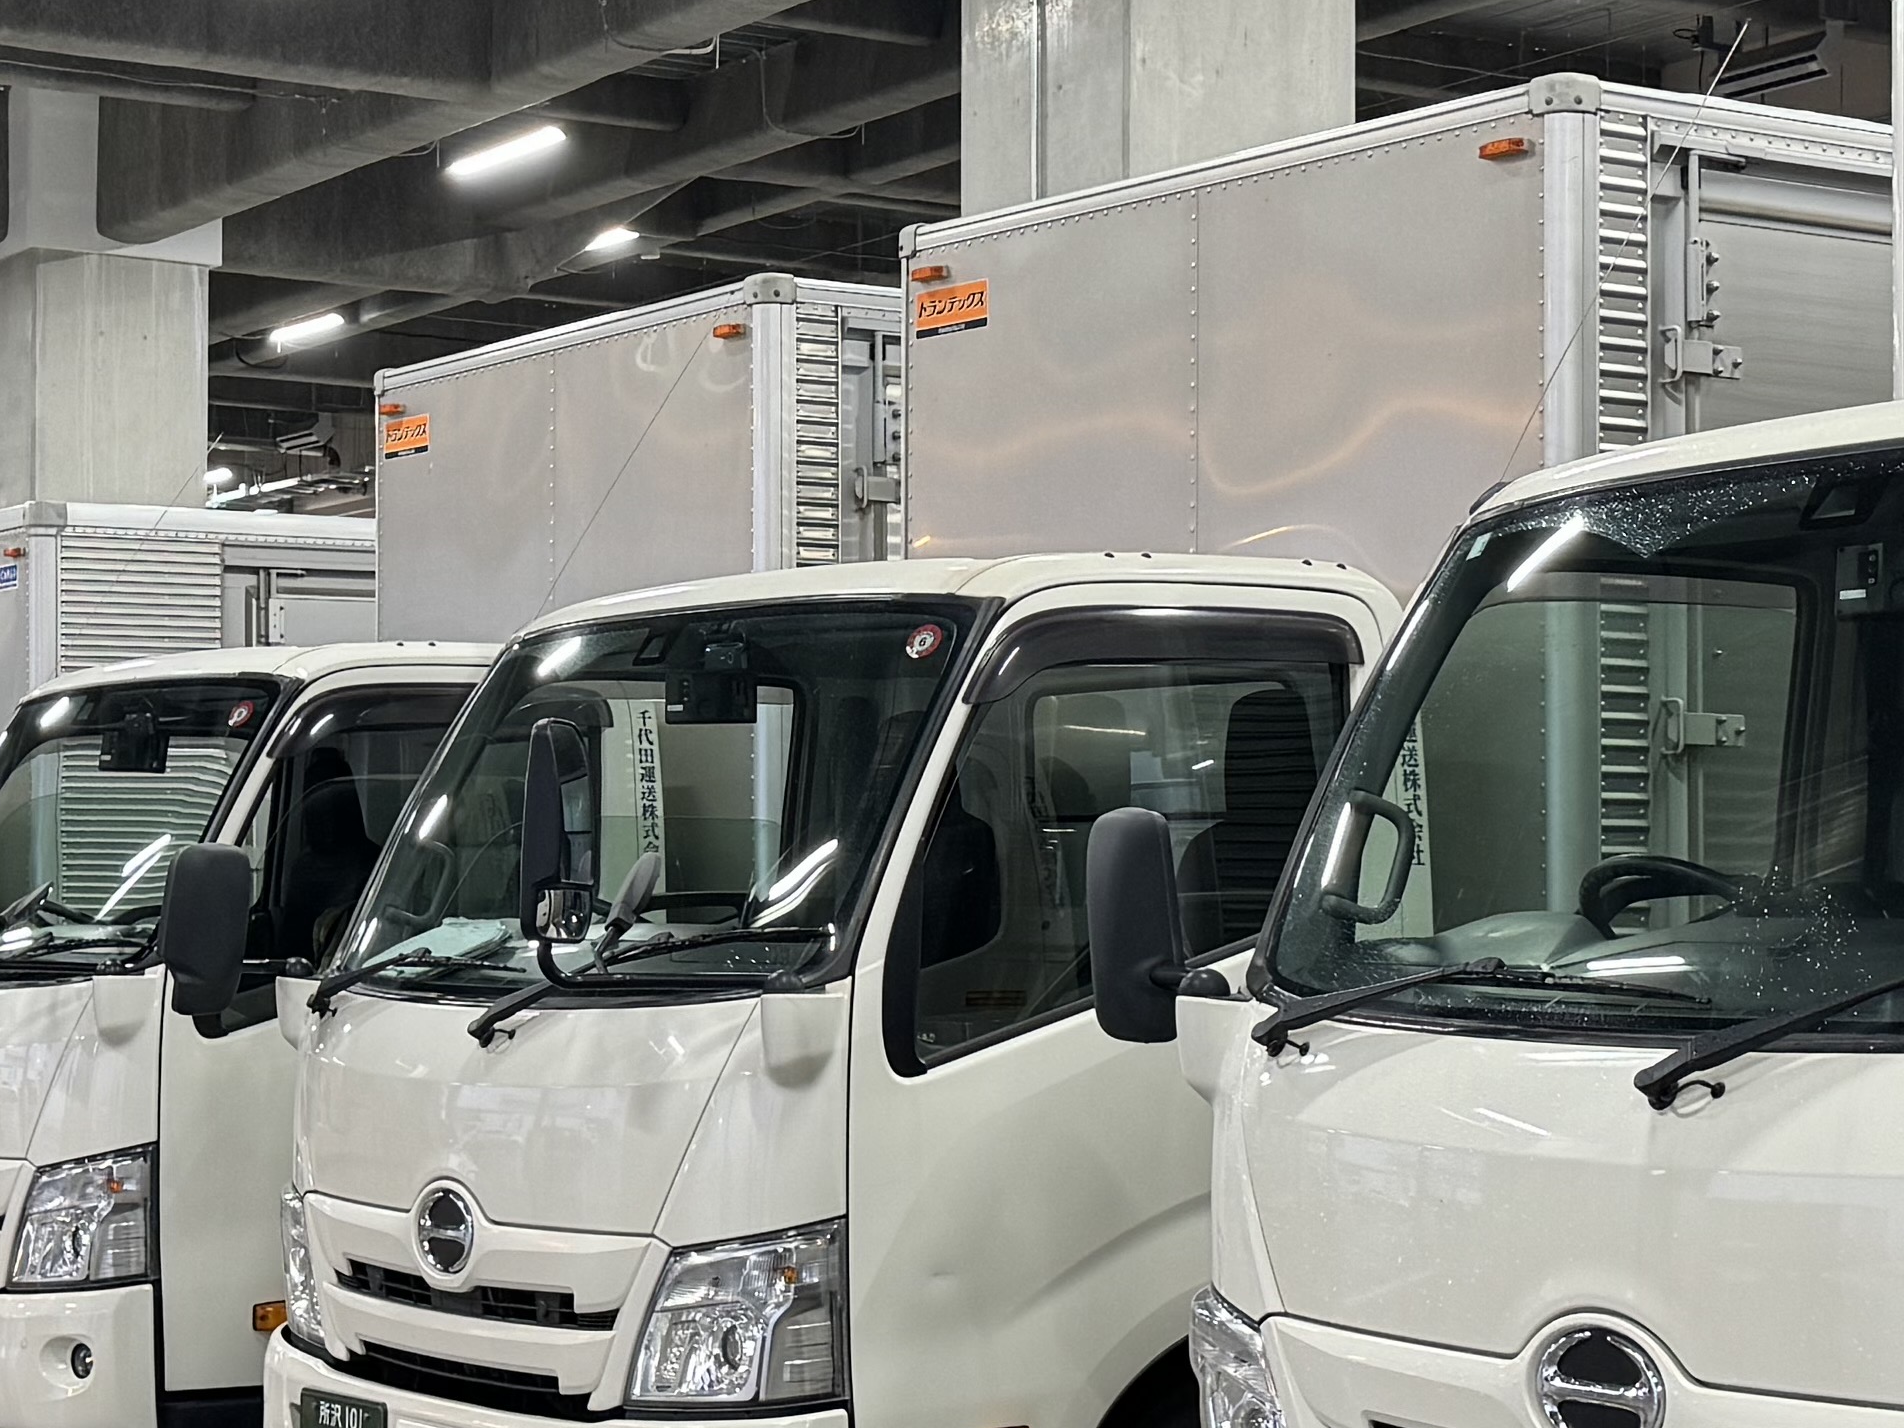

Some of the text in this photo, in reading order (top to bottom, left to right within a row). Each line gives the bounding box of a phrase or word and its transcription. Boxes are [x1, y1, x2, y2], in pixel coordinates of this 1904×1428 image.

[918, 290, 985, 319] トランテックス
[318, 1400, 342, 1428] 所沢
